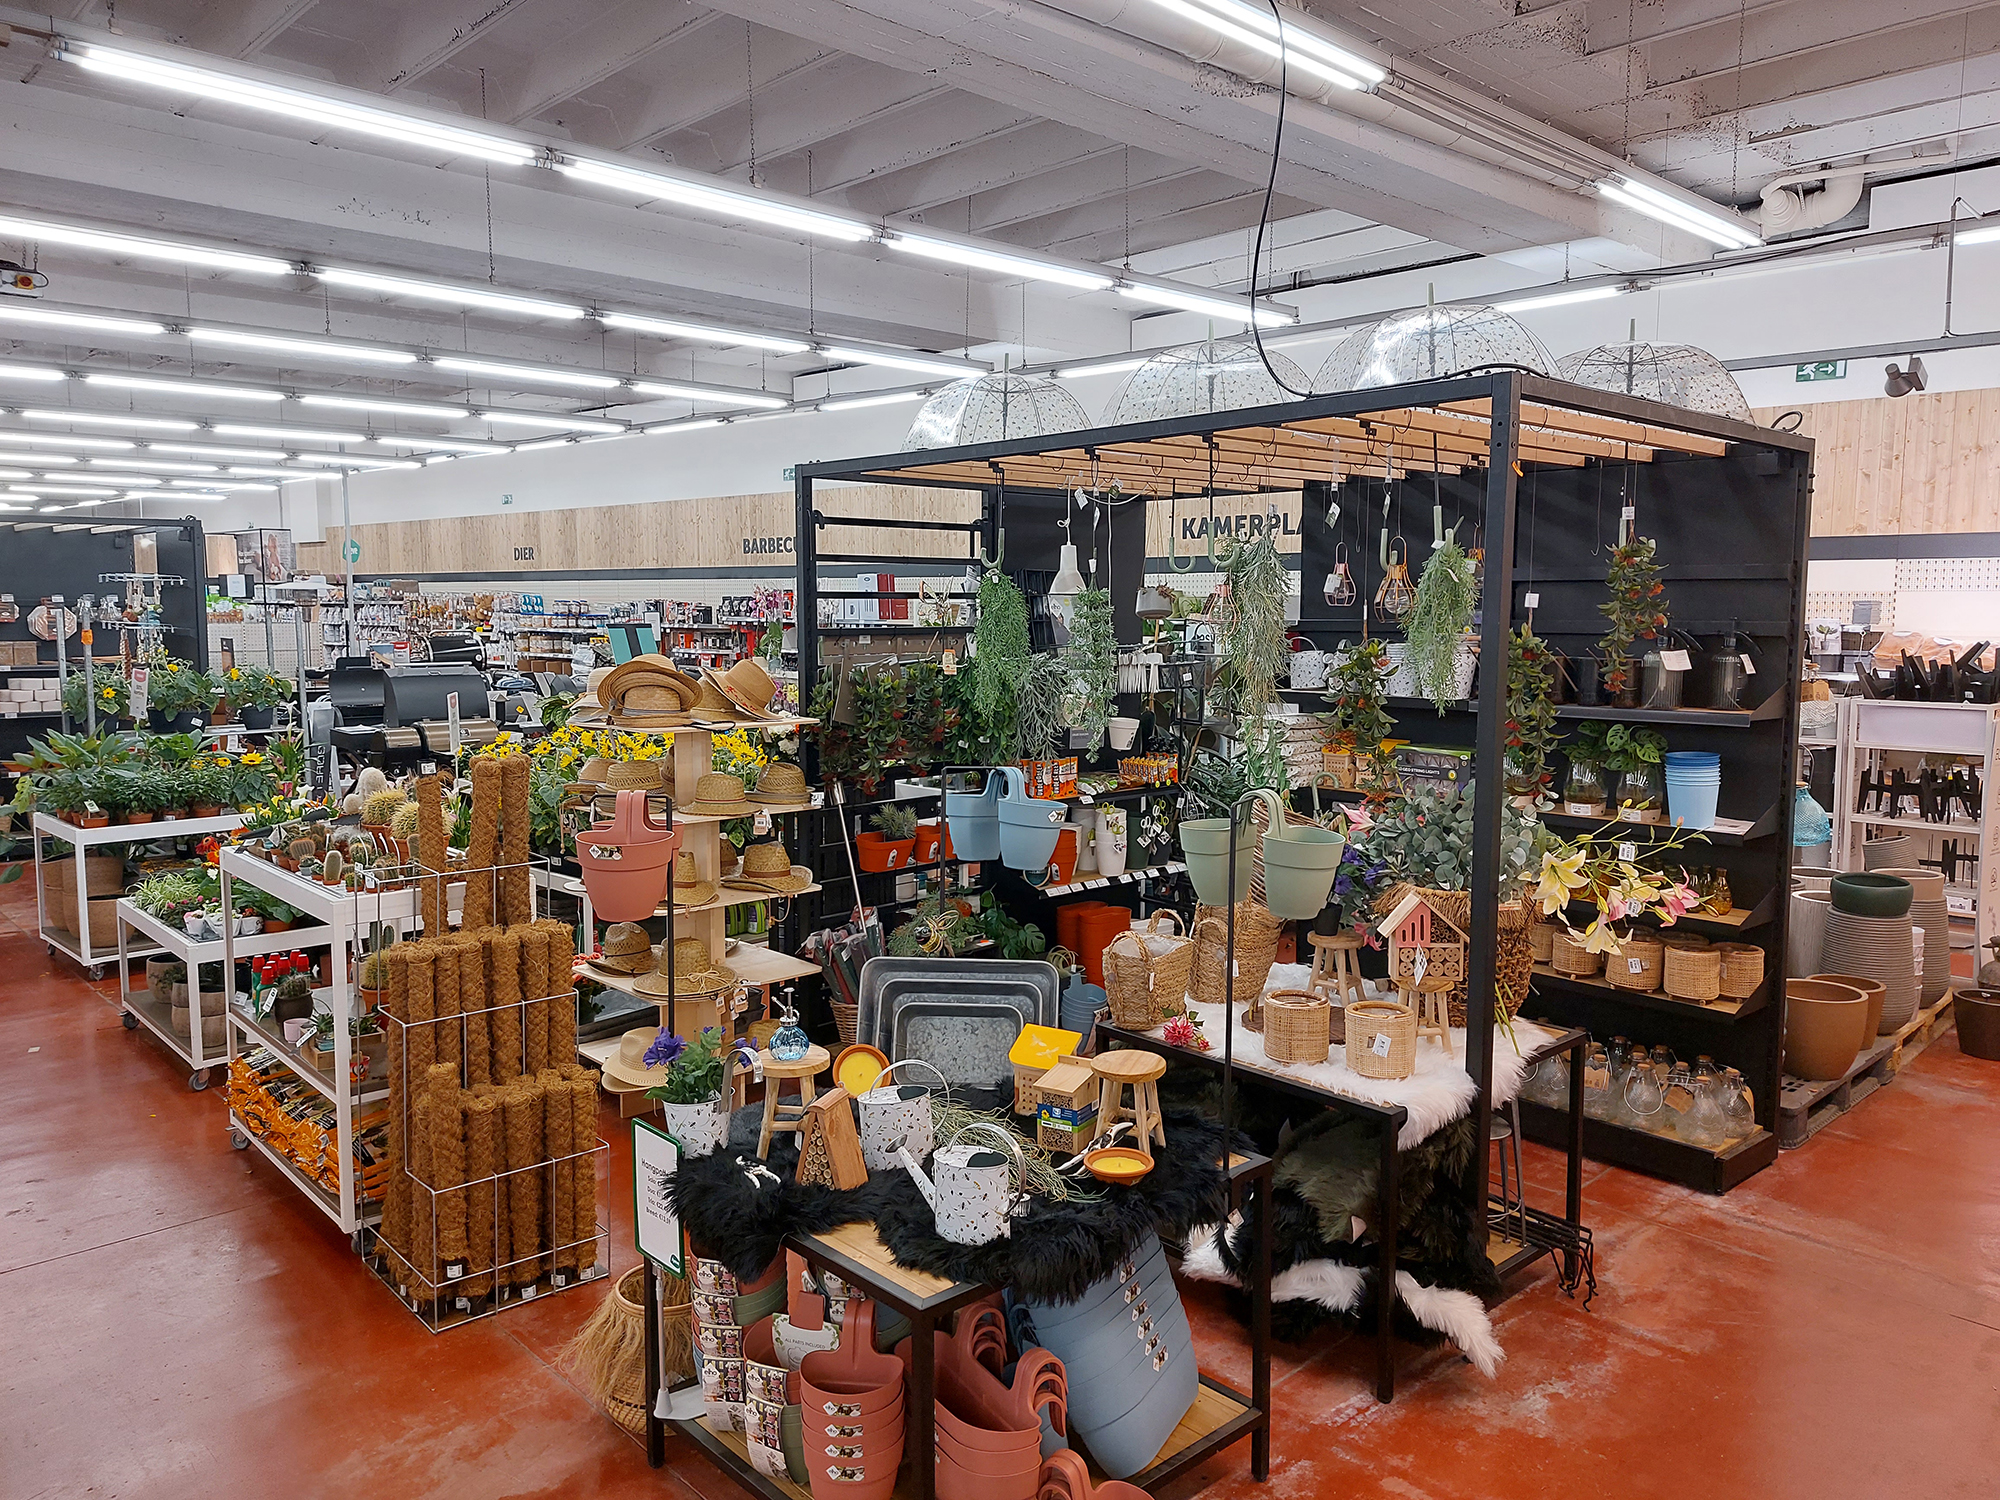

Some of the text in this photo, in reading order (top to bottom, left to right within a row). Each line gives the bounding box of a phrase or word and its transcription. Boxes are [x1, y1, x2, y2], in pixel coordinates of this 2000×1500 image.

[743, 536, 797, 554] BARBEC
[513, 547, 535, 561] DIER
[698, 1270, 712, 1278] elho
[825, 1275, 839, 1283] elho
[695, 1300, 708, 1309] elho
[701, 1335, 715, 1343] elho
[805, 1341, 826, 1349] INCLUDED
[703, 1368, 718, 1377] elho
[747, 1373, 761, 1383] elho
[745, 1407, 758, 1417] elho
